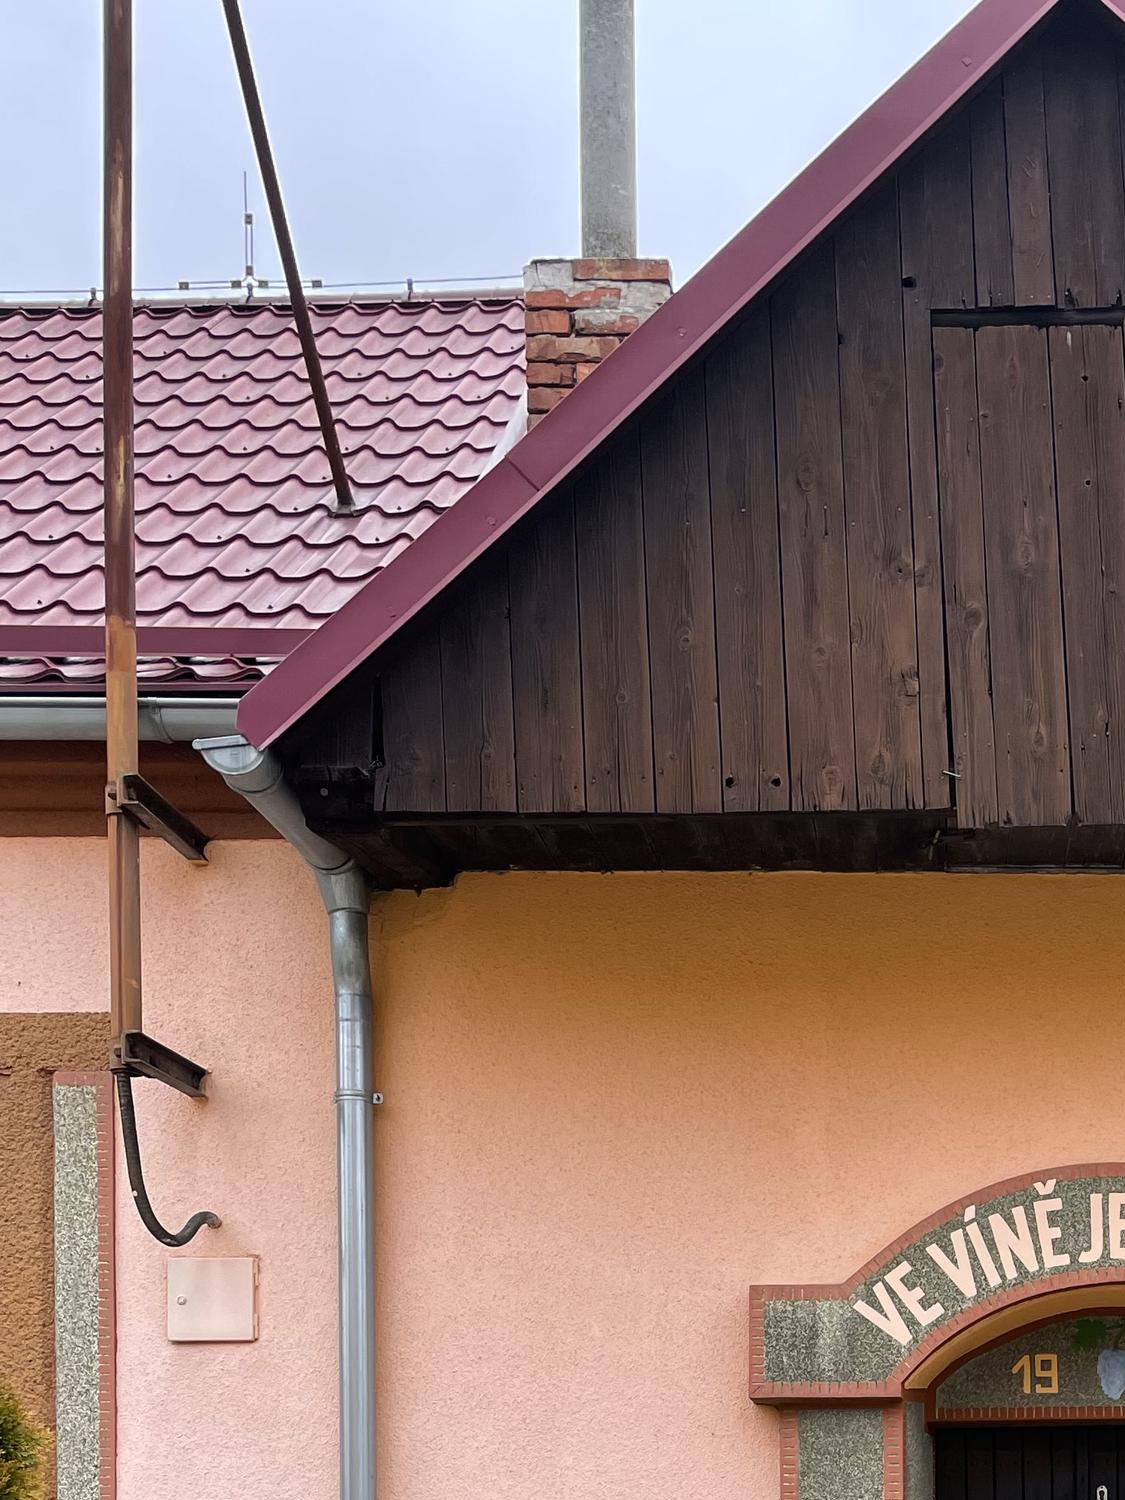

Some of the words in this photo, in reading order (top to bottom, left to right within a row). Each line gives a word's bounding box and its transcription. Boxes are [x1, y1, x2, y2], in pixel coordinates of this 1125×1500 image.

[853, 1261, 944, 1348] VE
[925, 1178, 1070, 1298] VÍNĚ
[1011, 1353, 1059, 1394] 19
